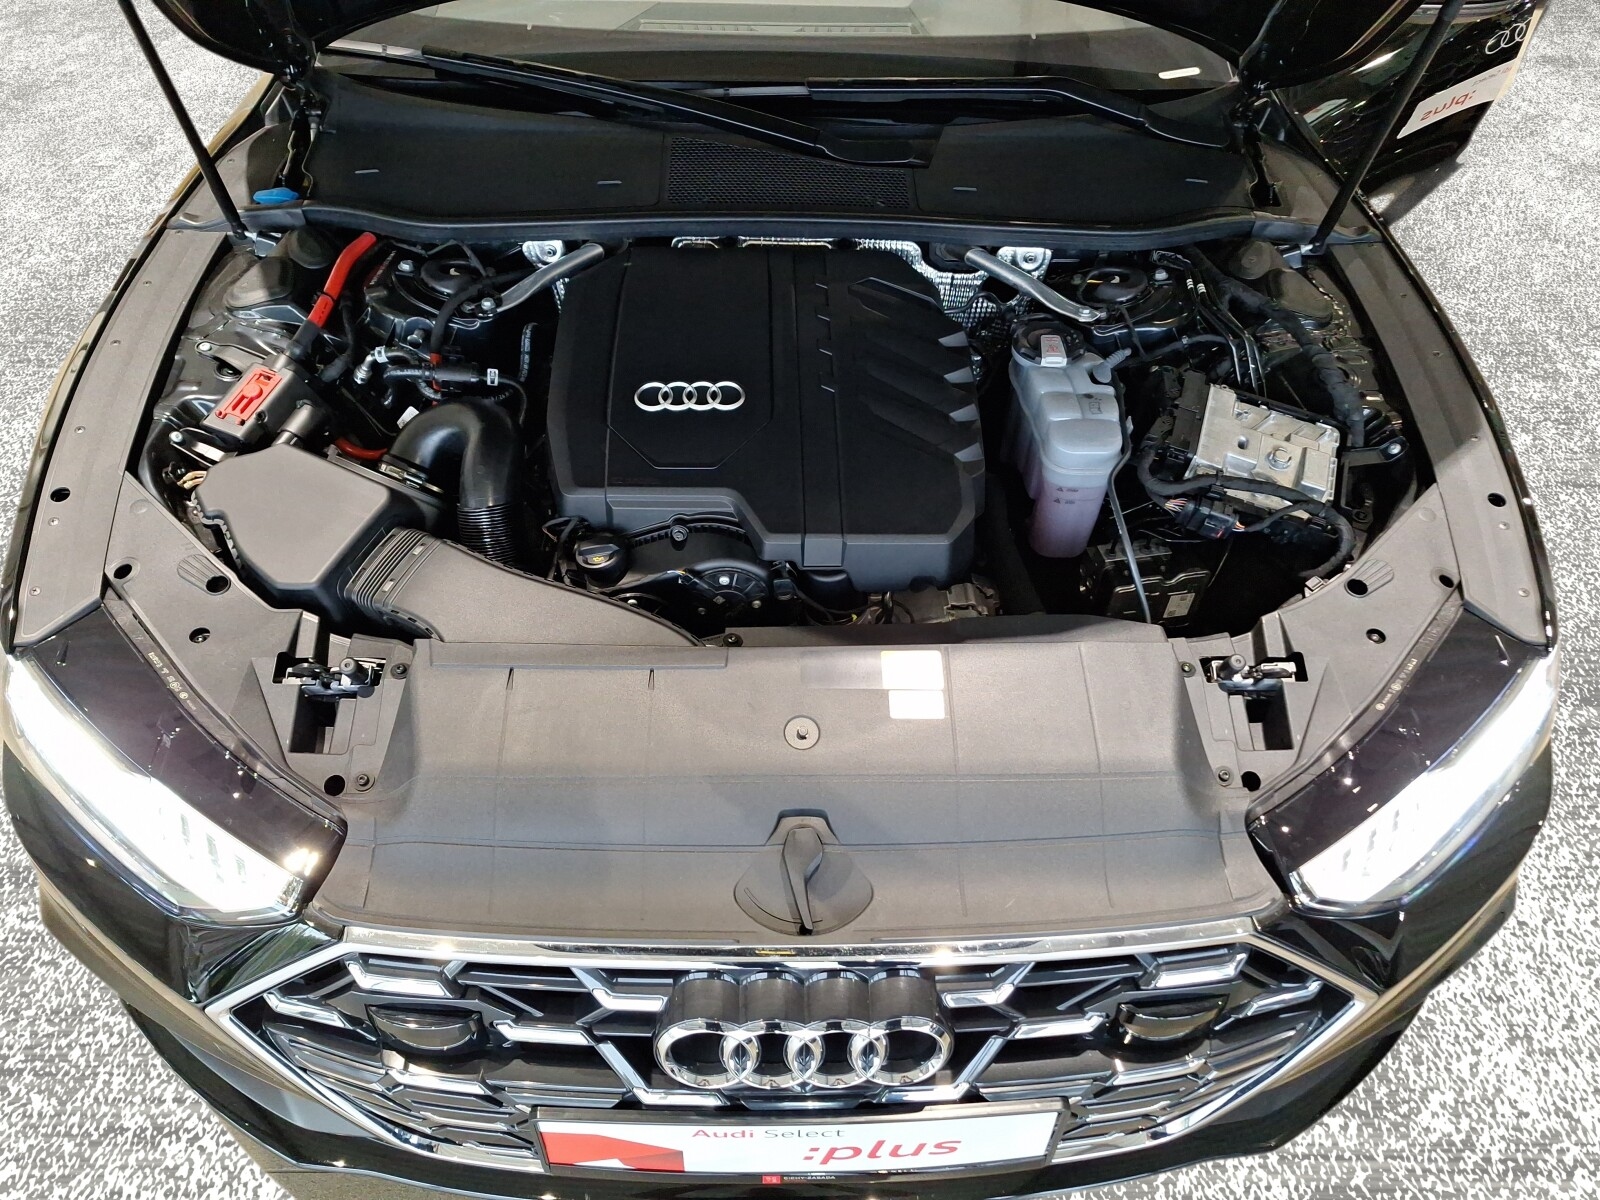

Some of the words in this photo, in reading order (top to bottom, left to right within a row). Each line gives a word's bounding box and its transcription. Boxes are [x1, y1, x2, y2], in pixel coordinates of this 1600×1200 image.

[692, 1129, 754, 1139] Audi
[764, 1128, 845, 1139] Select
[803, 1139, 962, 1165] :plus
